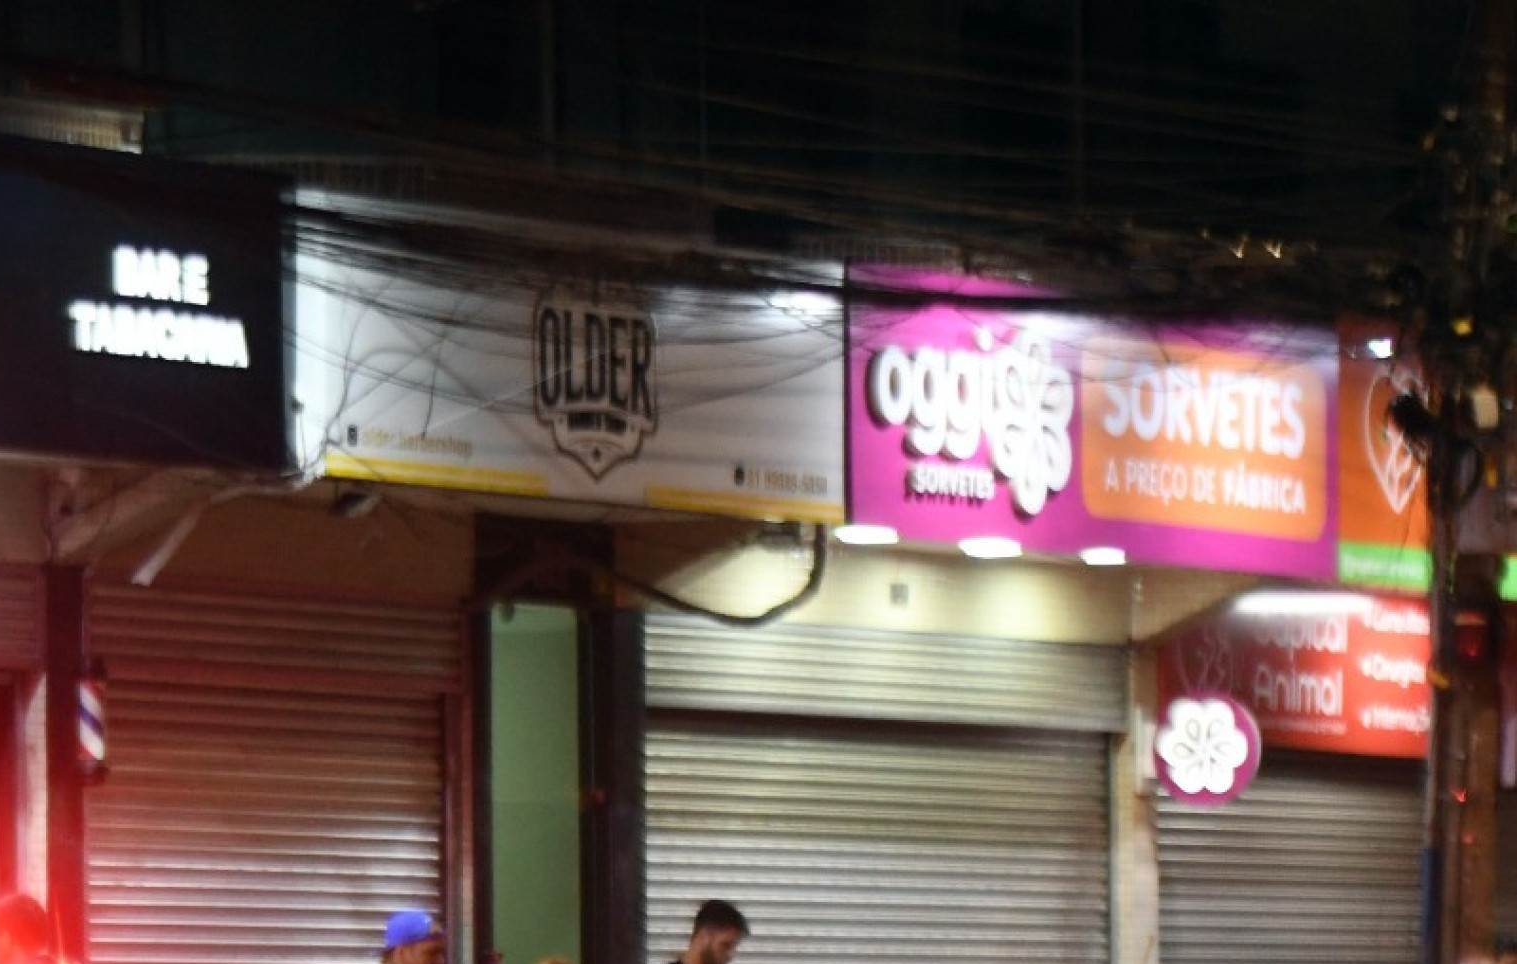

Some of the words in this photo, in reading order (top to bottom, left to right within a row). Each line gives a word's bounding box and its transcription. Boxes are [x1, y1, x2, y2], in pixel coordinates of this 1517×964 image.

[539, 307, 653, 420] OLDER
[1103, 359, 1306, 460] SORVETES
[1105, 457, 1120, 492] A
[1125, 458, 1189, 506] PREÇO
[1191, 466, 1217, 505] DE
[1252, 662, 1344, 717] Animal
